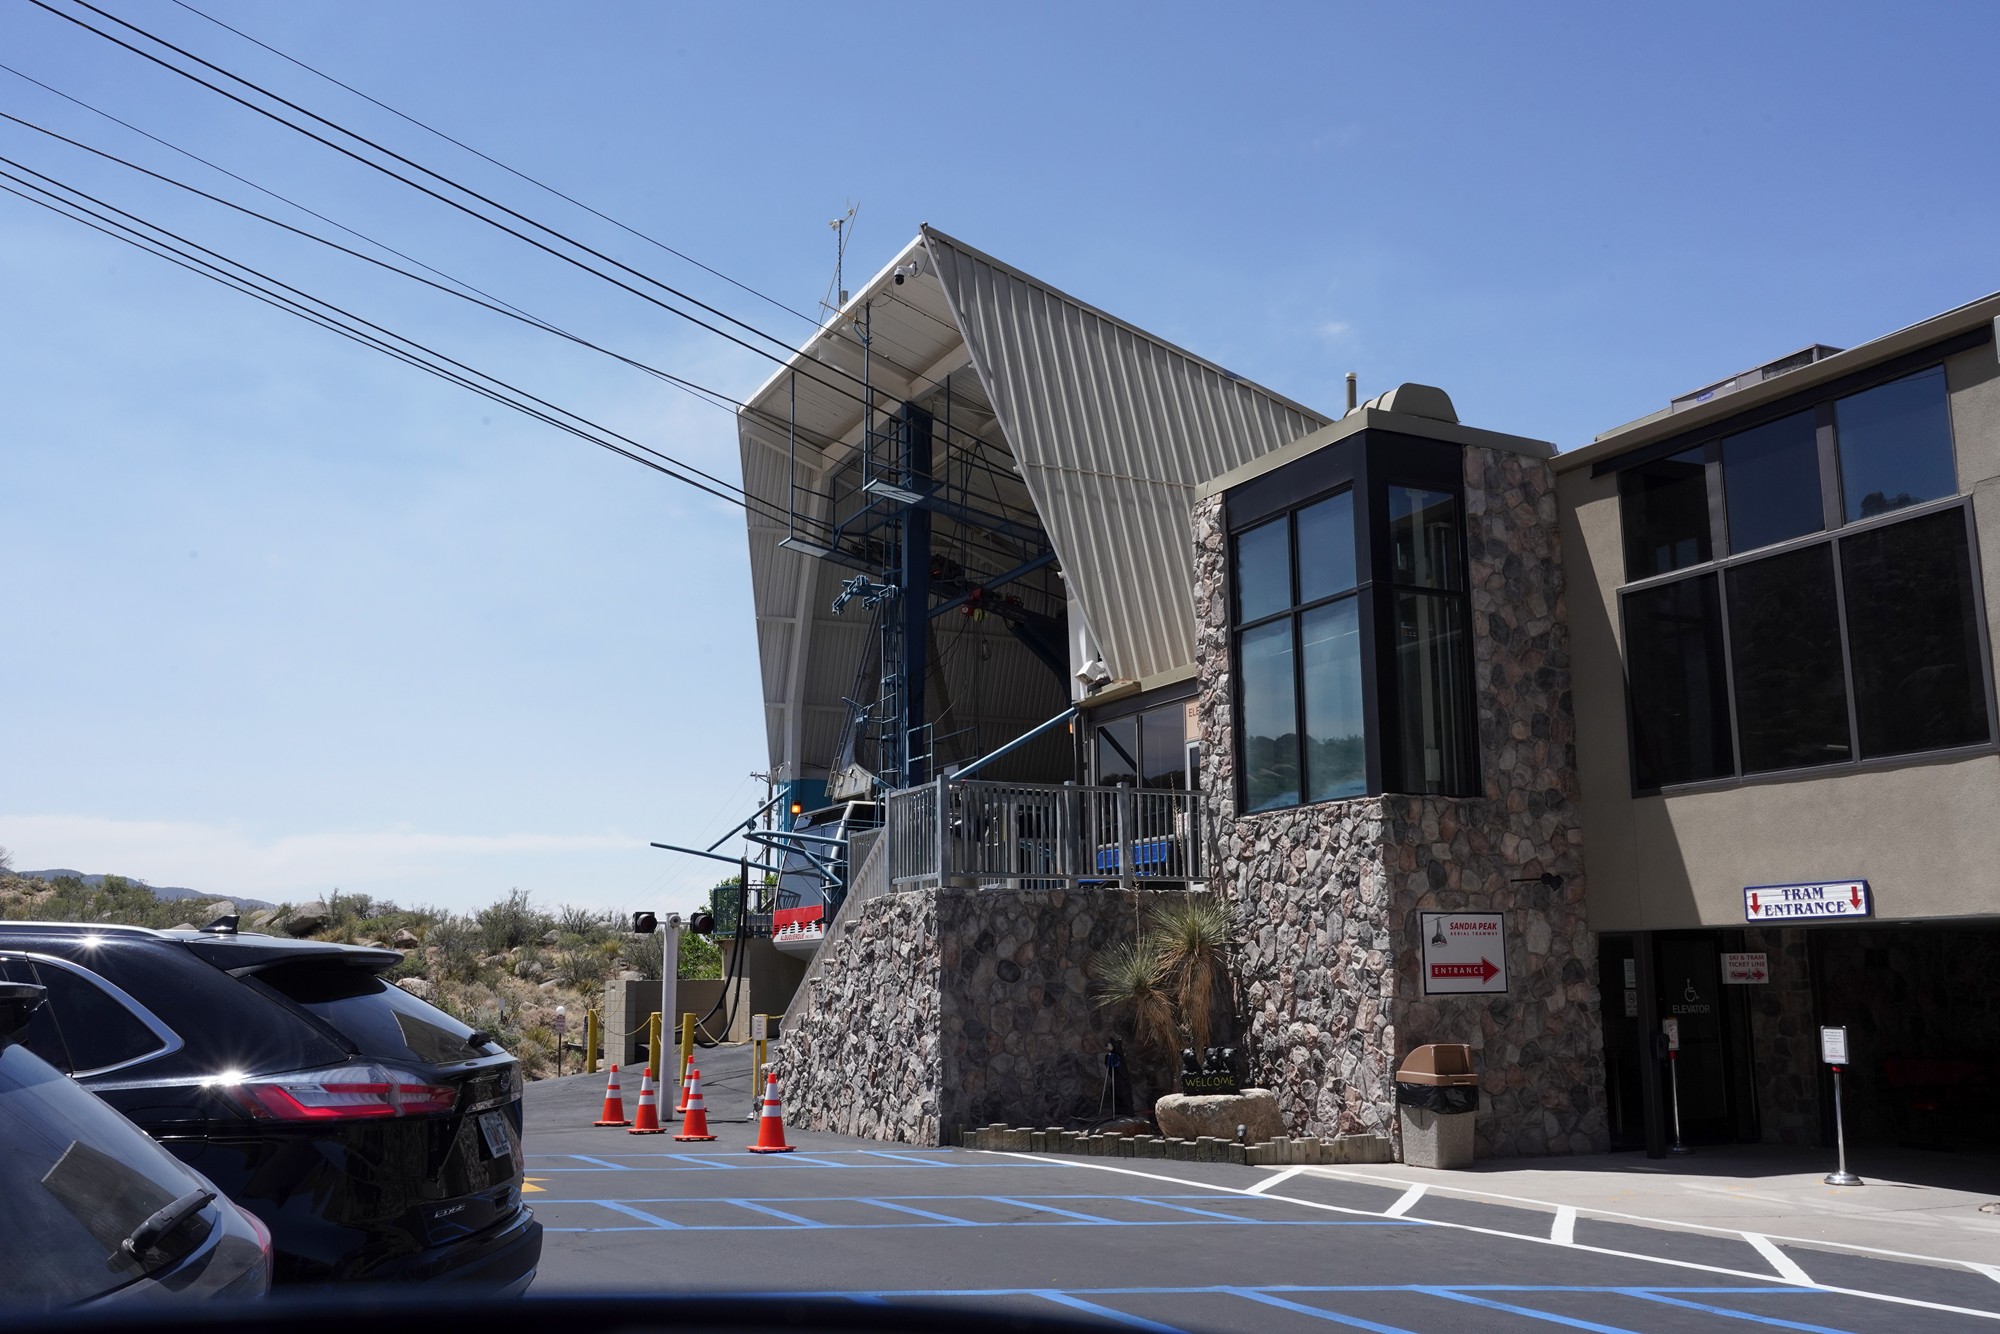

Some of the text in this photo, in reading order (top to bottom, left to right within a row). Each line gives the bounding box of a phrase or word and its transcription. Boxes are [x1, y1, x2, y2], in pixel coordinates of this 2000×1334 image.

[1781, 887, 1824, 901] TRAM
[1764, 901, 1847, 917] ENTRANCE
[1449, 922, 1498, 930] SANDIA PEAK
[1434, 966, 1484, 974] ENTRANCE
[1672, 1004, 1711, 1014] ELEVATOR
[1184, 1075, 1235, 1087] WELCOME
